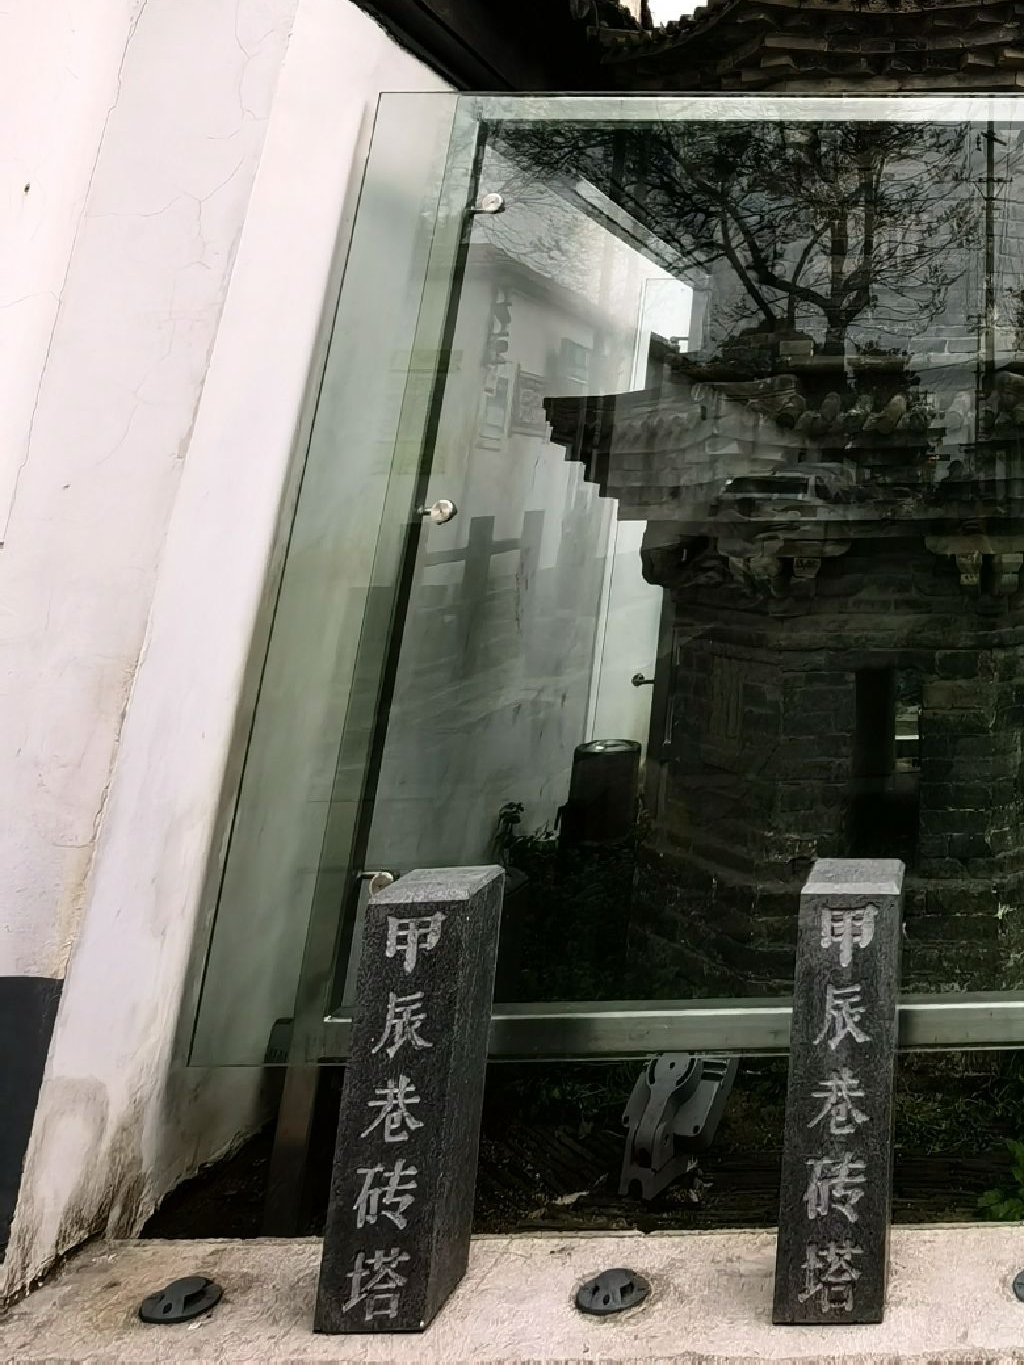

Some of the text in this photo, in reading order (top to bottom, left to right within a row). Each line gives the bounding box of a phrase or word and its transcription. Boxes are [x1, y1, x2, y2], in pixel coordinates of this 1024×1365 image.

[342, 911, 445, 1321] 甲辰巷砖塔
[798, 905, 878, 1312] 甲辰巷砖塔
